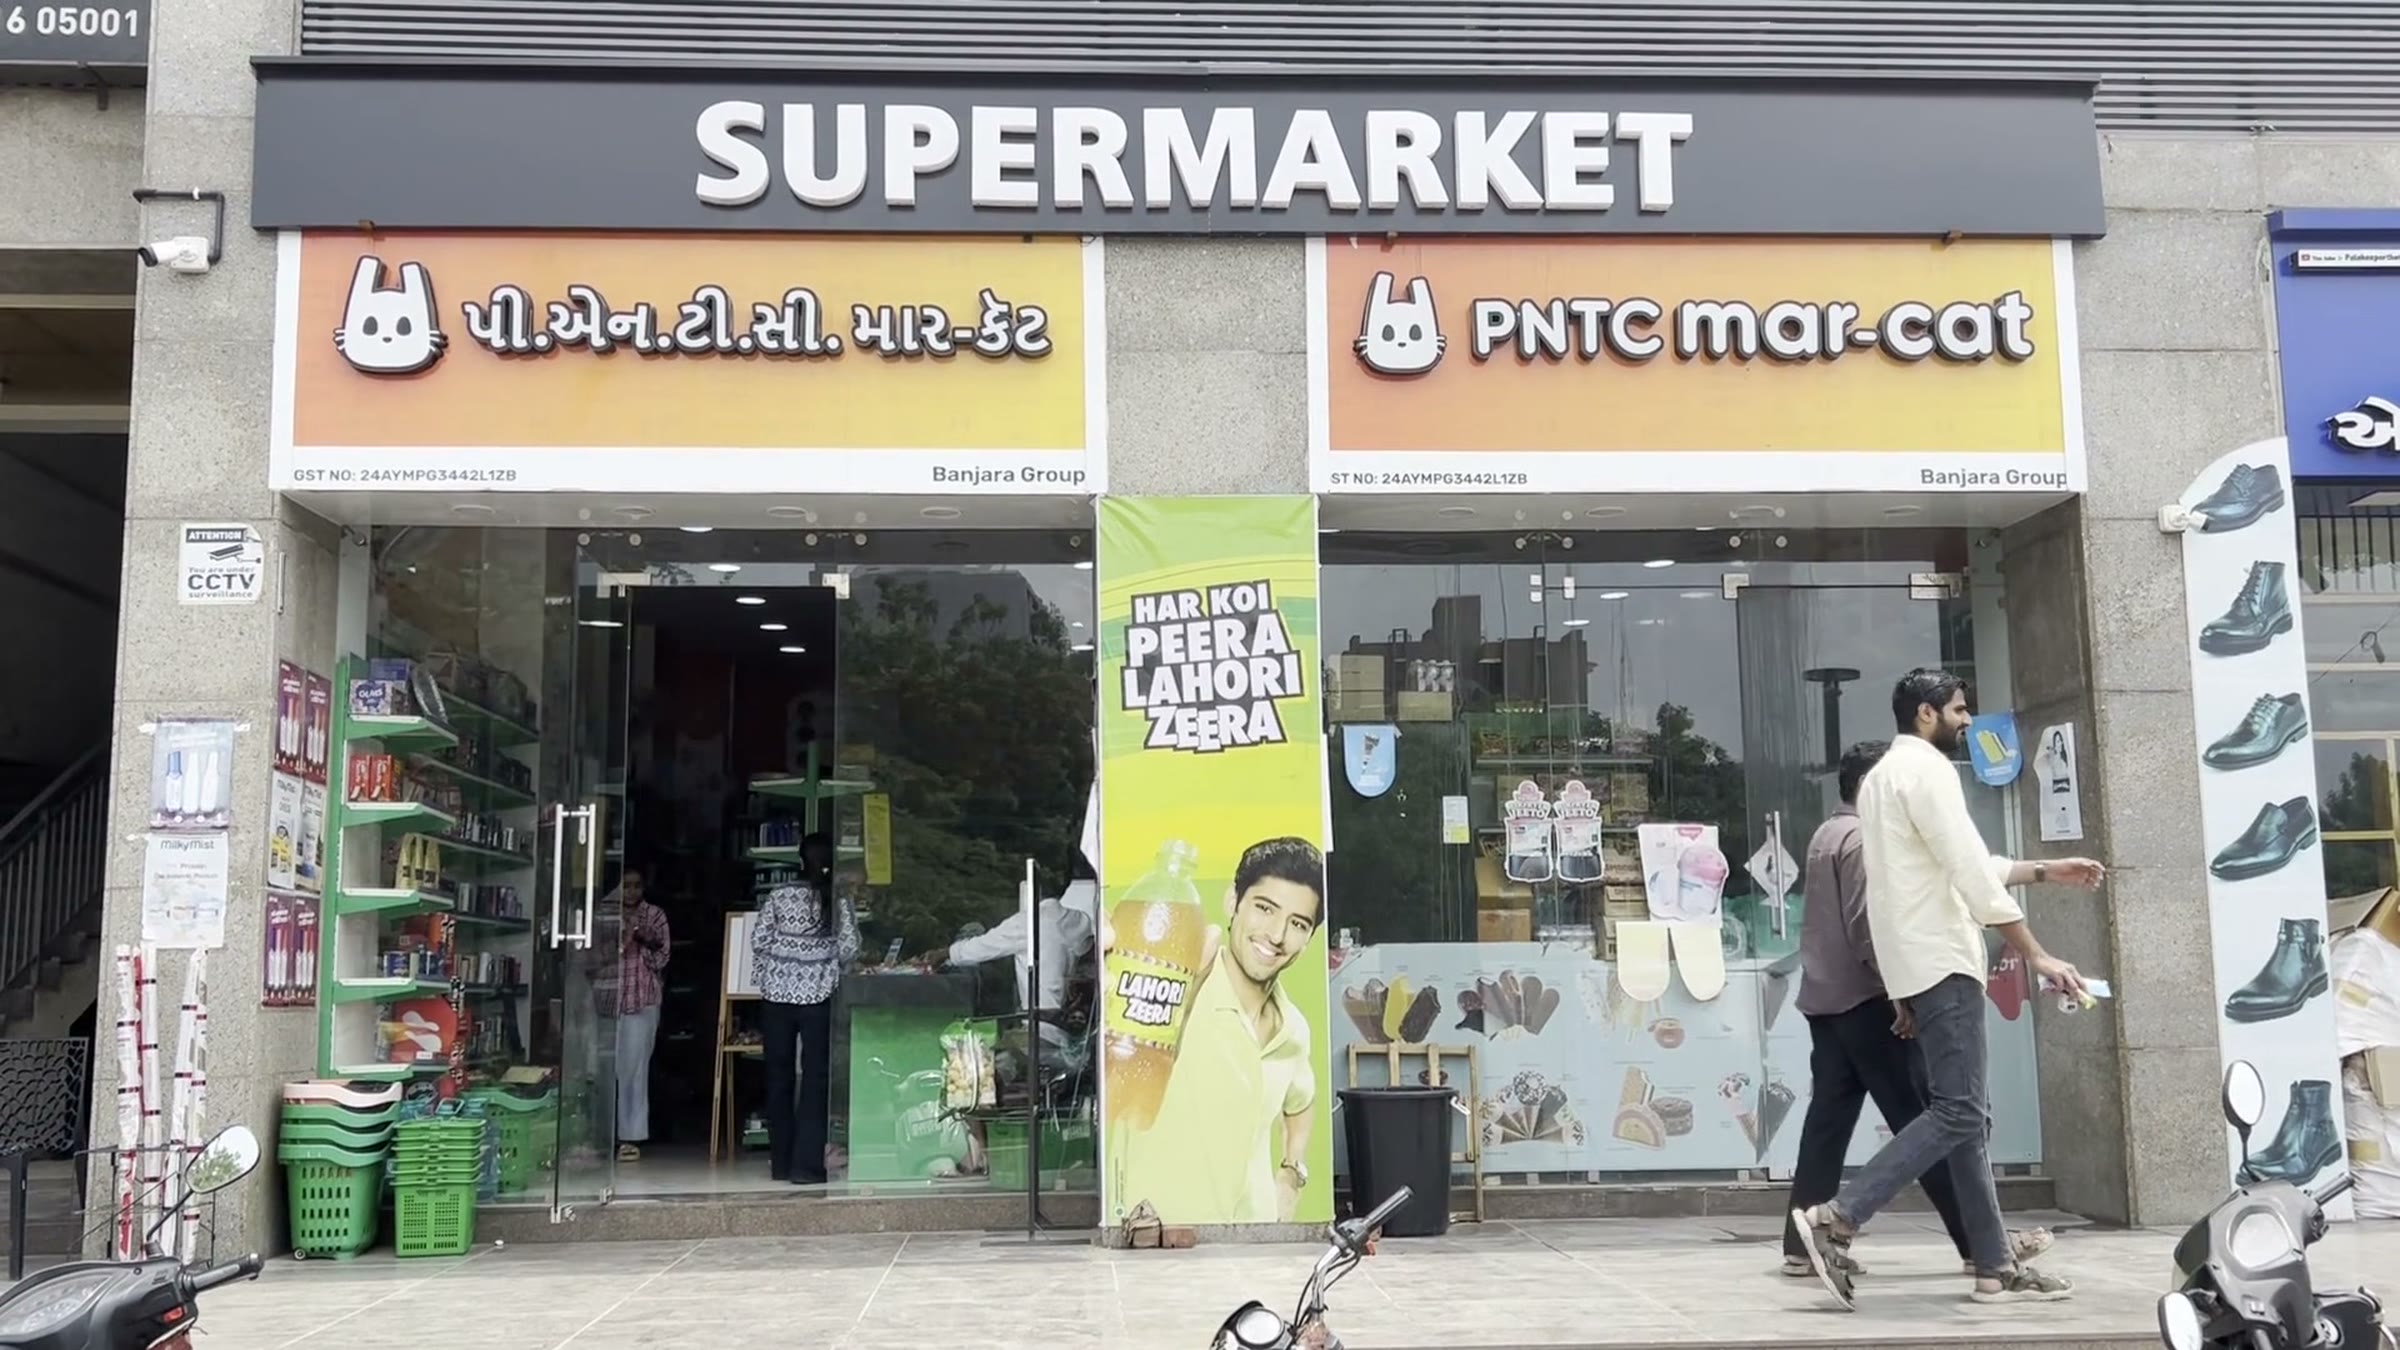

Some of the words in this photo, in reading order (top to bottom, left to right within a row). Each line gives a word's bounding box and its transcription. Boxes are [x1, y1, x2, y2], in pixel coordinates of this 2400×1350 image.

[37, 7, 138, 37] 05001
[695, 100, 1694, 212] SUPERMARKET
[463, 285, 843, 353] પી.એન.ટી.સી.
[852, 289, 1051, 355] માર-કેટ
[1471, 298, 1664, 360] PNTC
[1675, 290, 2035, 361] mar-cat
[293, 469, 325, 482] GST
[329, 469, 356, 482] NO:
[360, 469, 517, 482] 24AYMPG3442L1ZB
[932, 466, 1015, 486] Banjara
[1021, 466, 1086, 486] Group
[1353, 472, 1378, 485] NO:
[1382, 472, 1528, 485] 24AYMPG3442L1ZB
[1920, 468, 2000, 488] Banjara
[2006, 469, 2068, 489] Group
[188, 531, 242, 540] ATTENTION
[187, 573, 256, 590] CCTV
[188, 590, 253, 599] surveillance
[1134, 591, 1201, 624] HAR
[1210, 582, 1270, 616] KOI
[1128, 612, 1289, 668] PEERA
[1124, 653, 1301, 708] LAHORI
[1147, 699, 1283, 751] ZEERA
[1118, 971, 1186, 1005] LAHORI
[1124, 996, 1172, 1025] ZEERA
